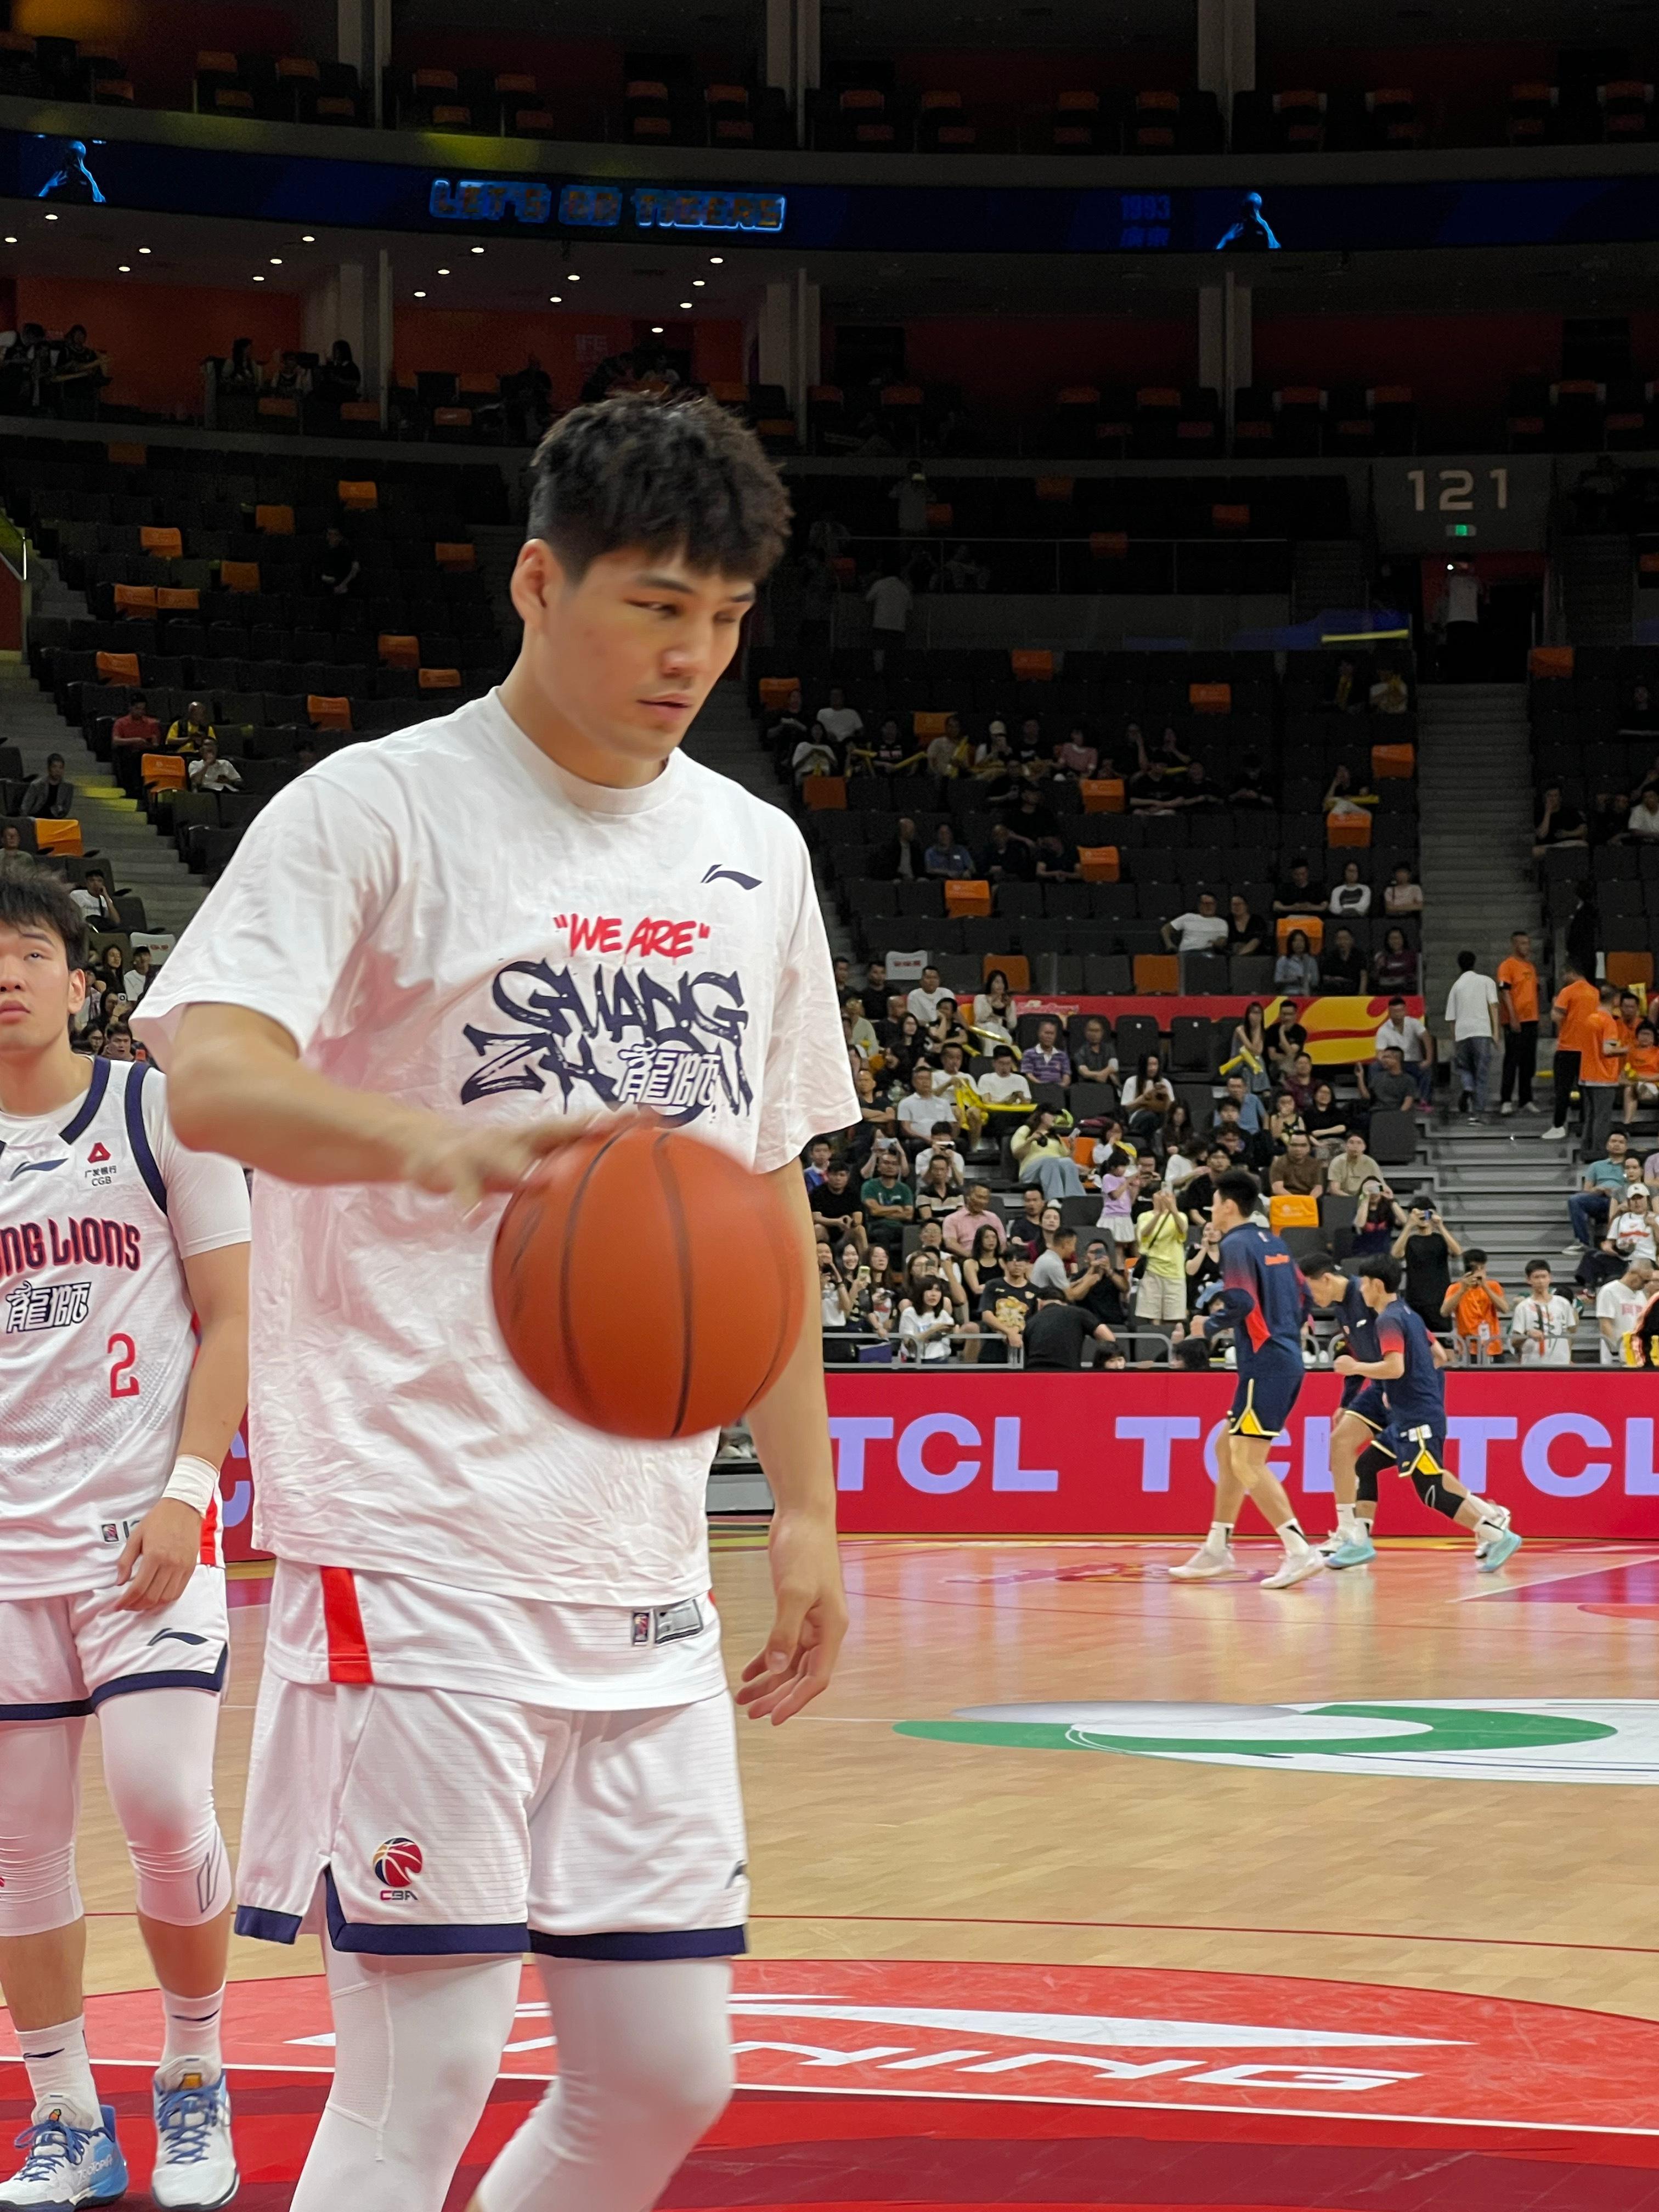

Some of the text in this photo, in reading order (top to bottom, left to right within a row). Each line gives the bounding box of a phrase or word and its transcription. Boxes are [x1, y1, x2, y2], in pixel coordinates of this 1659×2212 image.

[1407, 469, 1508, 511] 121
[92, 1176, 112, 1187] CGB
[48, 1216, 141, 1272] LIONS
[107, 1333, 140, 1398] 2
[828, 1413, 1059, 1494] TCL
[1115, 1417, 1335, 1493] TL
[1446, 1413, 1659, 1497] TCL
[380, 1890, 418, 1900] CBA
